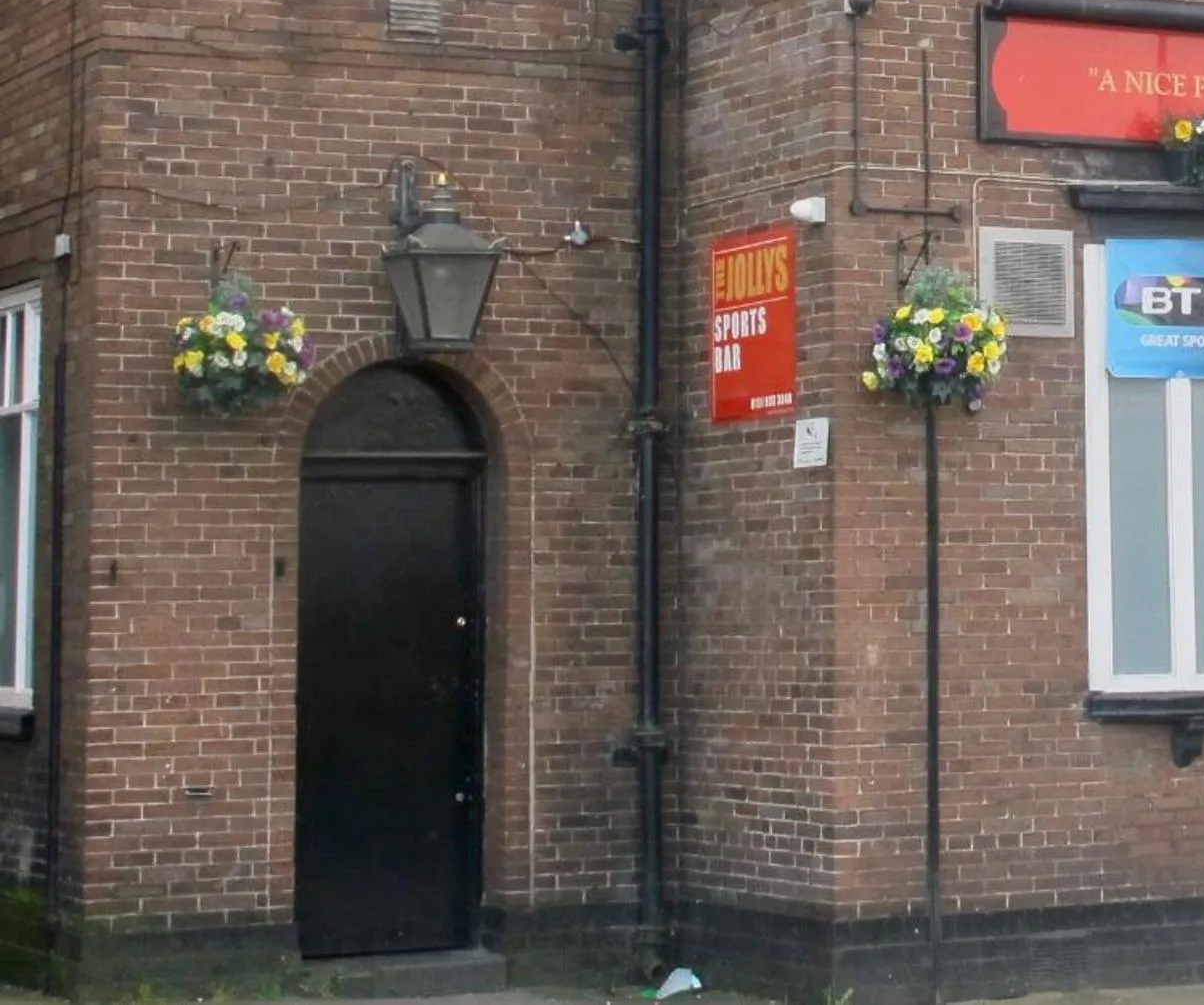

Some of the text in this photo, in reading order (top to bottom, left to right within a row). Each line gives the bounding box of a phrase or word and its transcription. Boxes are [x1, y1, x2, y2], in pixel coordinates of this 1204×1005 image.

[1124, 69, 1188, 97] NICE
[726, 244, 789, 302] JOLLYS
[1141, 286, 1202, 315] BT
[714, 306, 767, 343] SPORTS
[1140, 334, 1179, 347] GREAT
[715, 343, 741, 374] BAR
